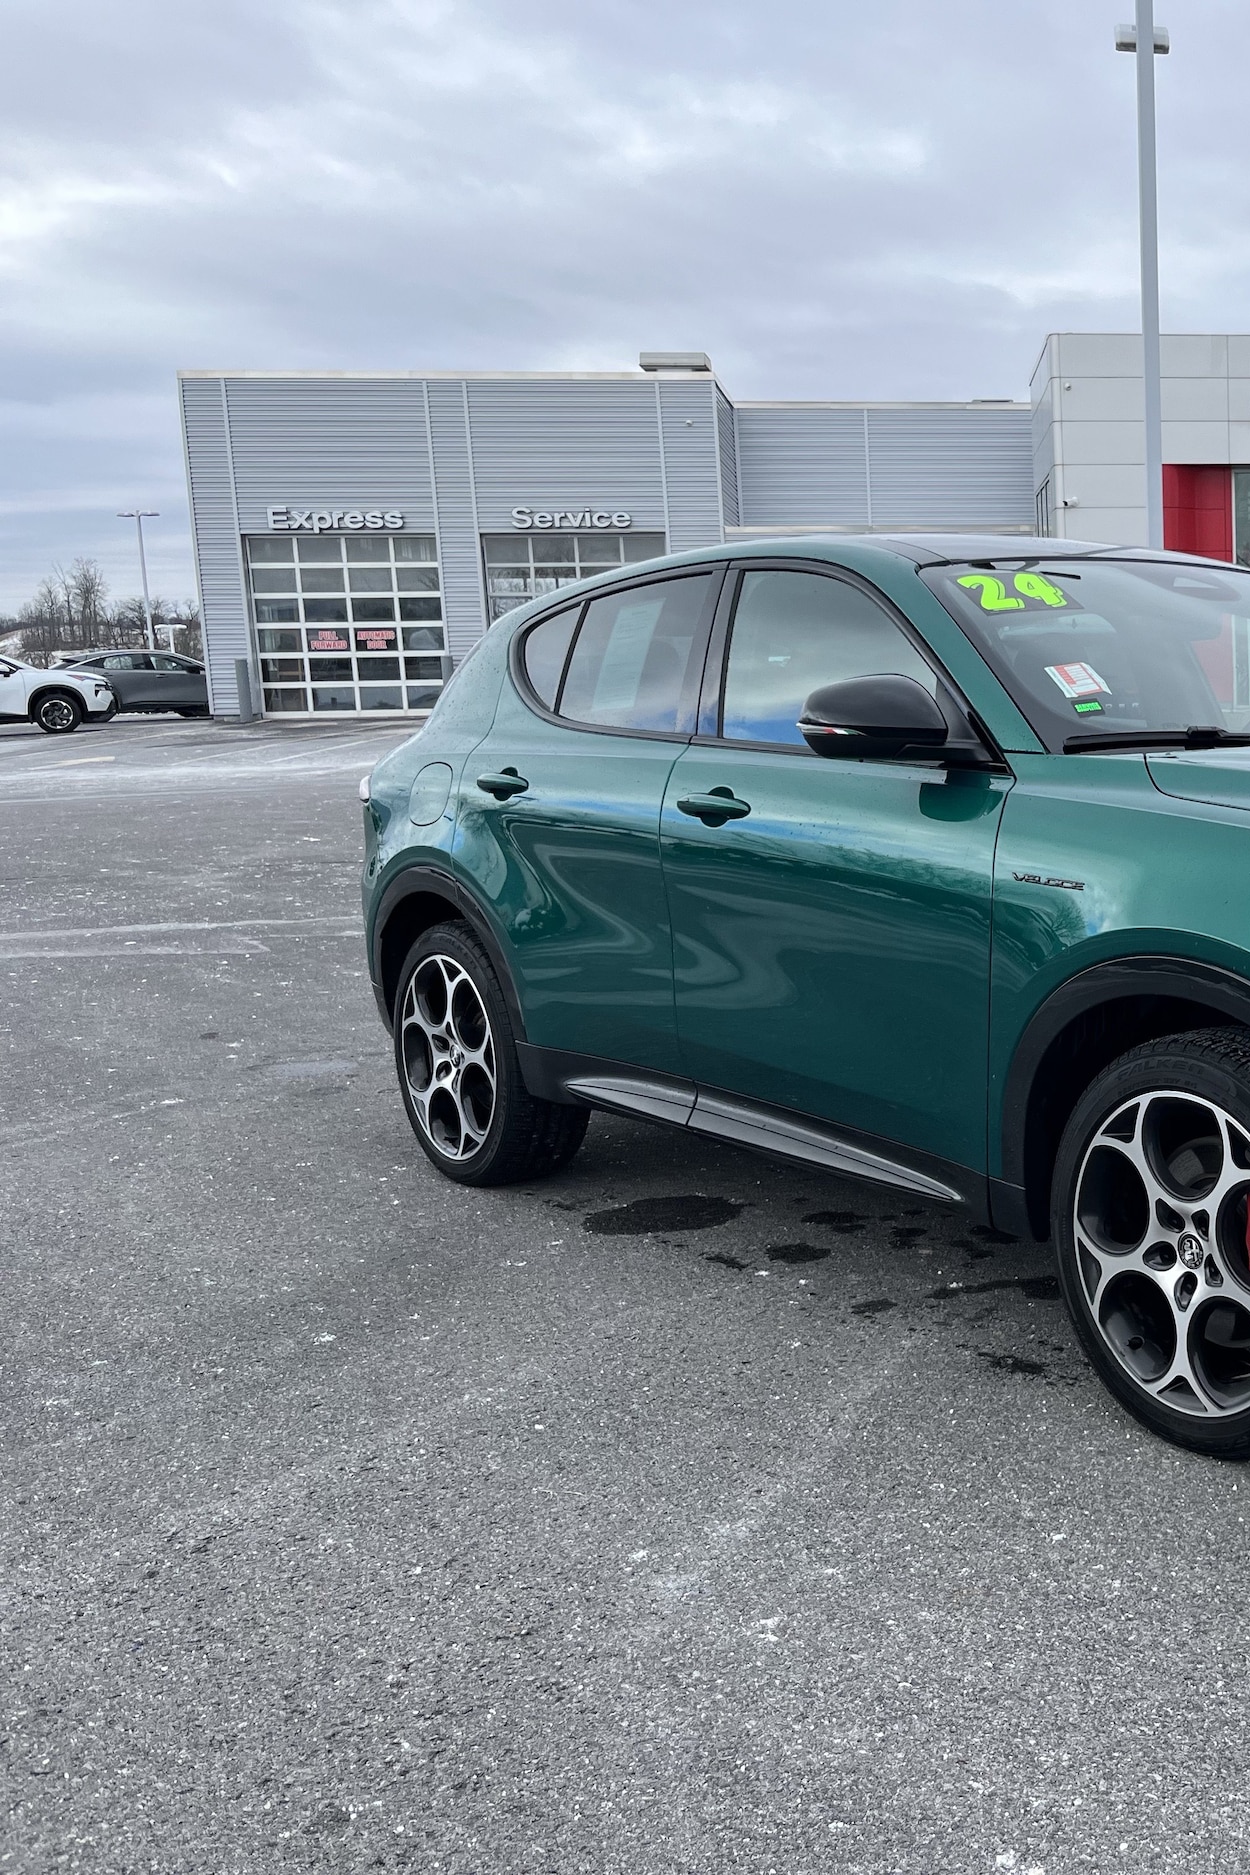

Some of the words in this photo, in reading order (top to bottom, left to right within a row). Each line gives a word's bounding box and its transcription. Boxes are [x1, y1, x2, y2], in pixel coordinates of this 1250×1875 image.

[266, 505, 404, 534] Express
[511, 507, 632, 529] Service
[957, 572, 1067, 611] 24
[318, 631, 339, 640] PULL
[357, 631, 396, 640] AUTOMATIC
[311, 640, 347, 650] FORWARD
[367, 640, 388, 649] DOOR
[1012, 872, 1086, 891] VELOCE
